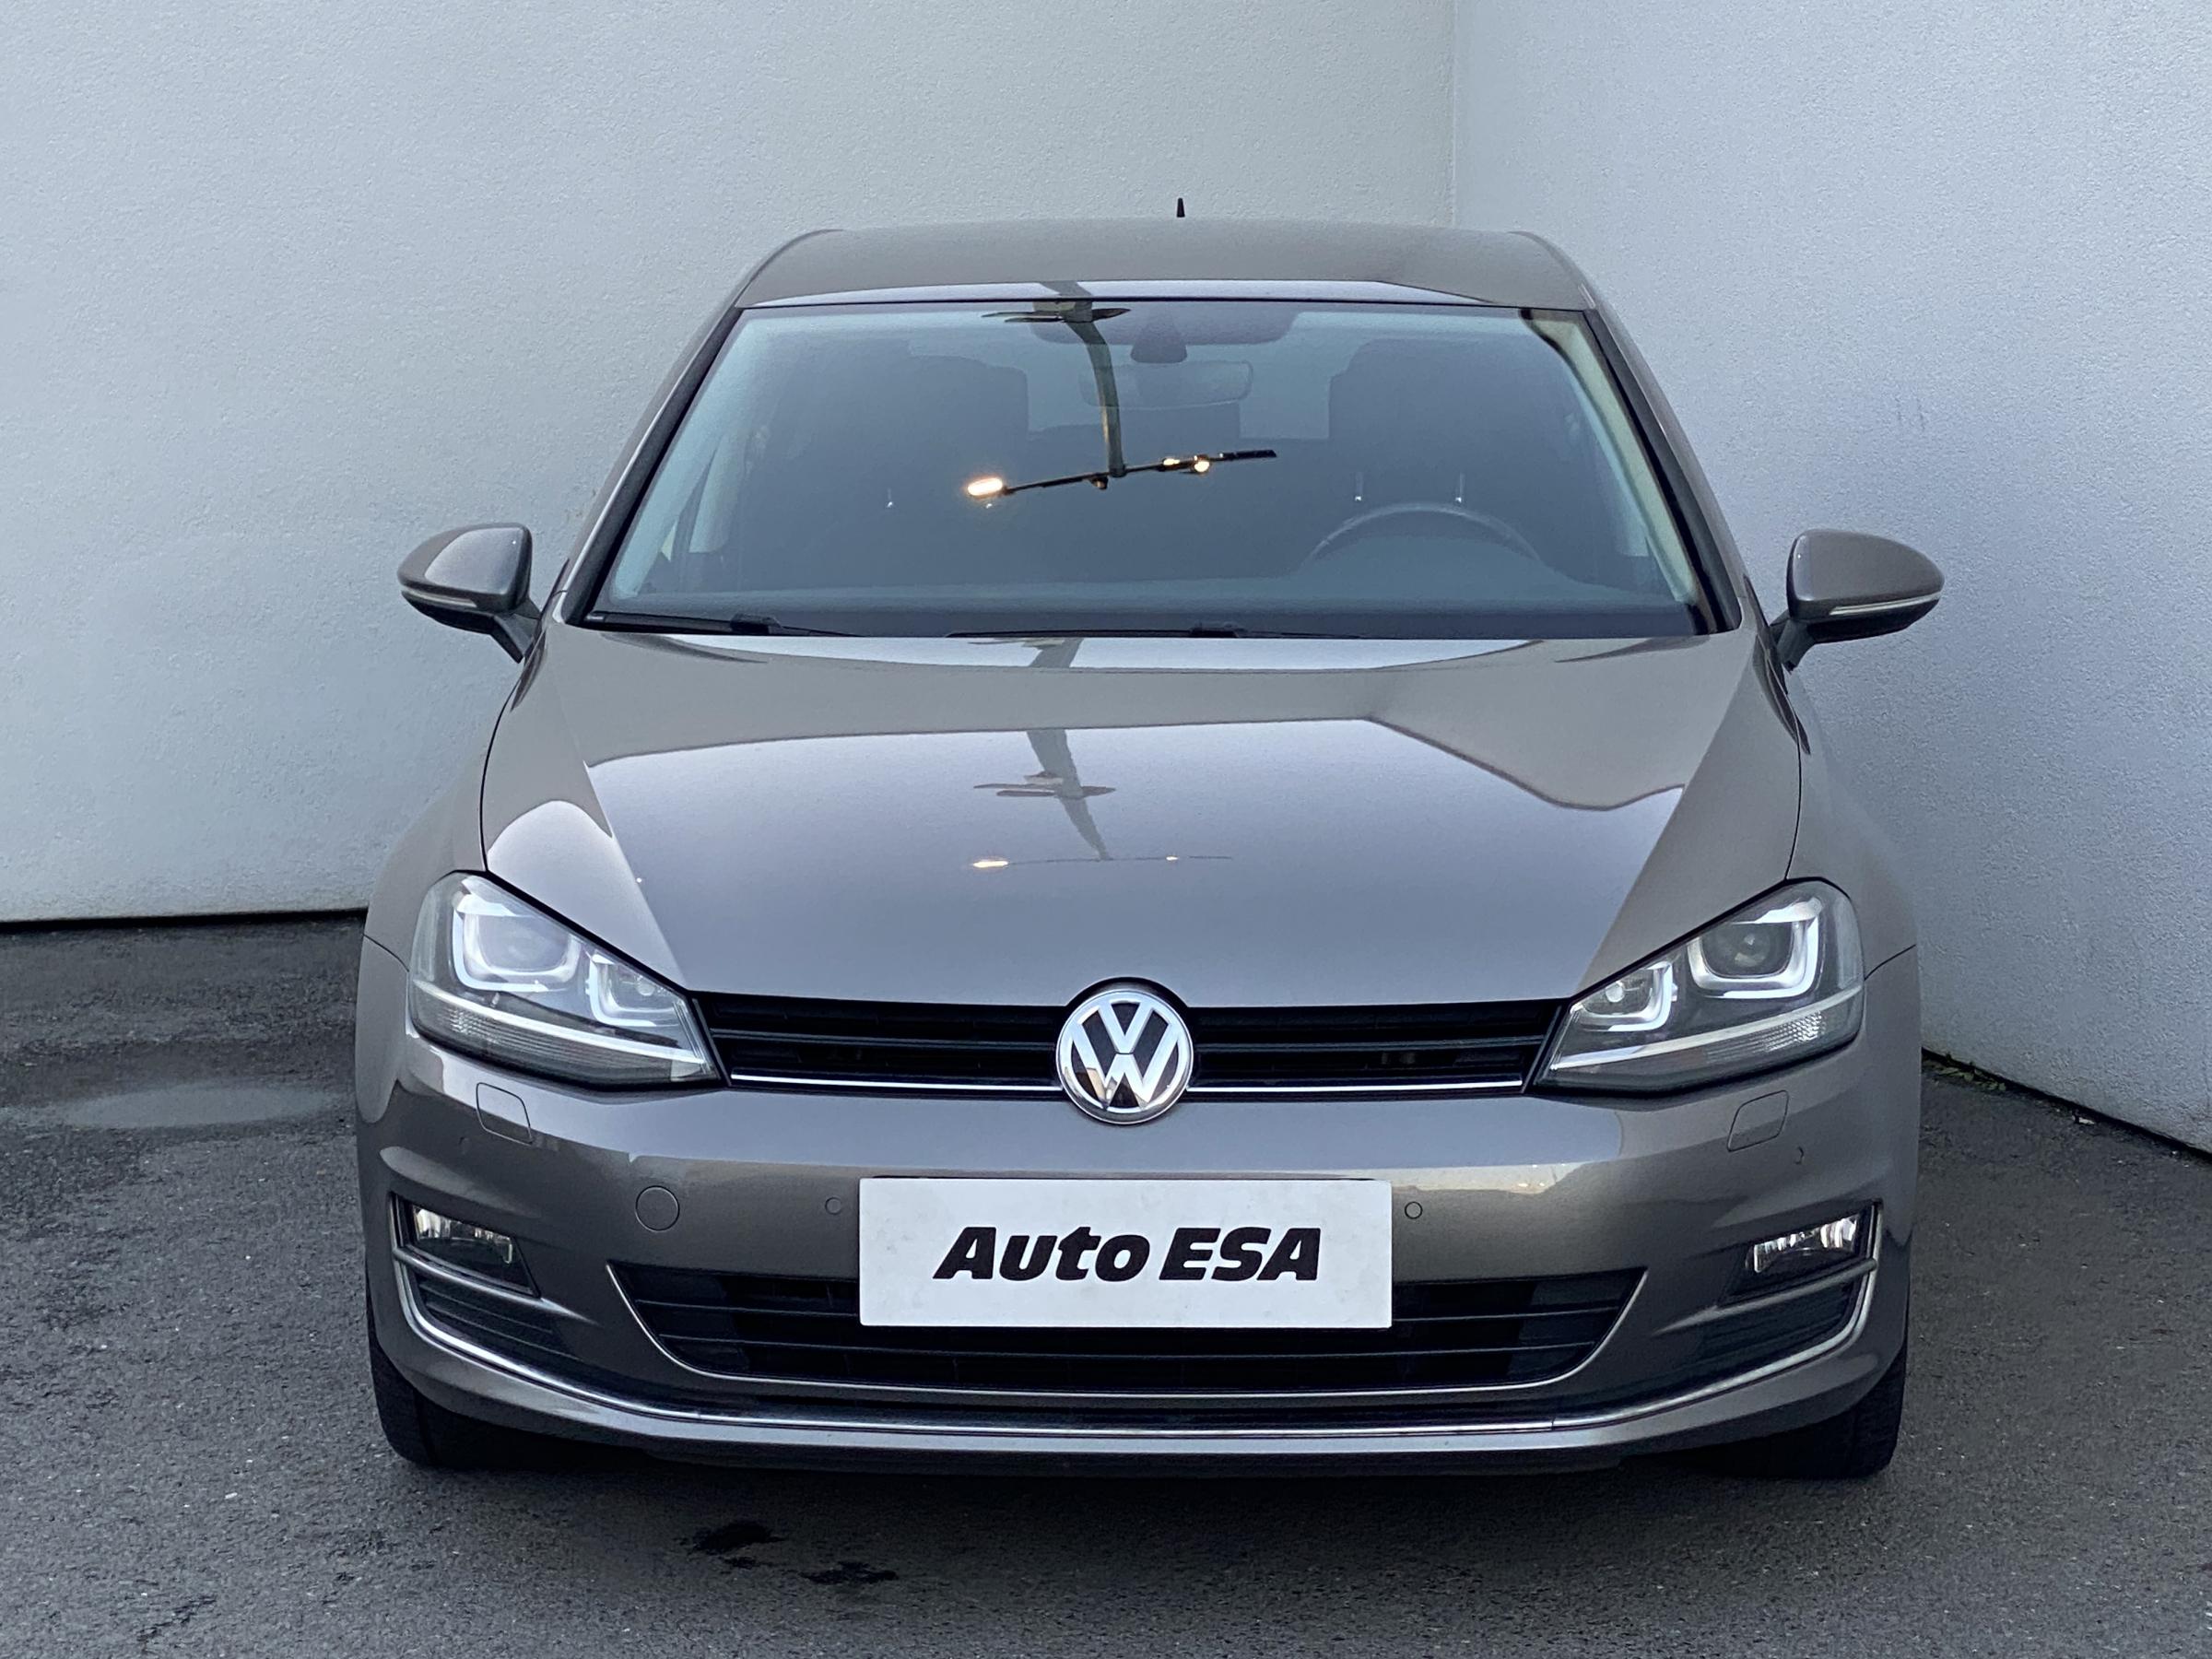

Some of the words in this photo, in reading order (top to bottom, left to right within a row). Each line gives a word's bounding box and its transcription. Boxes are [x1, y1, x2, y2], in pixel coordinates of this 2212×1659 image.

[1065, 997, 1183, 1114] VW
[932, 1226, 1150, 1282] Auto
[1159, 1226, 1322, 1282] ESA
